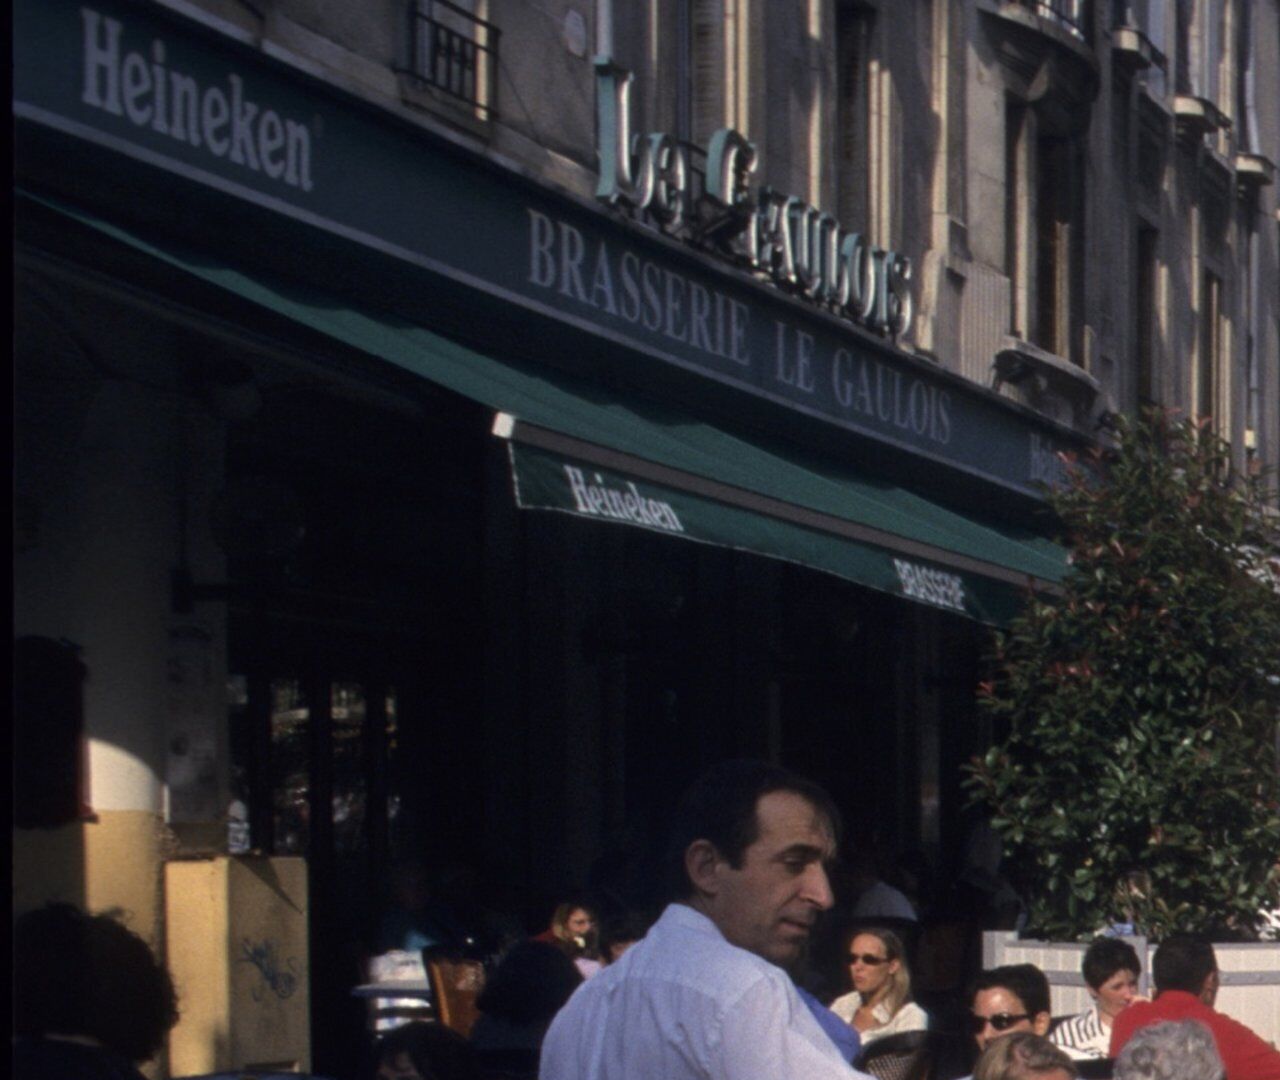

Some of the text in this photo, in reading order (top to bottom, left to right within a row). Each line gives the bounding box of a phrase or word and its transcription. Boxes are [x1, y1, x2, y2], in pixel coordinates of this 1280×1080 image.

[81, 6, 313, 192] Heineken
[528, 209, 951, 445] BRASSERIE LE GAULOIS
[563, 464, 684, 531] Heineken
[894, 557, 967, 612] BRASSERIE
